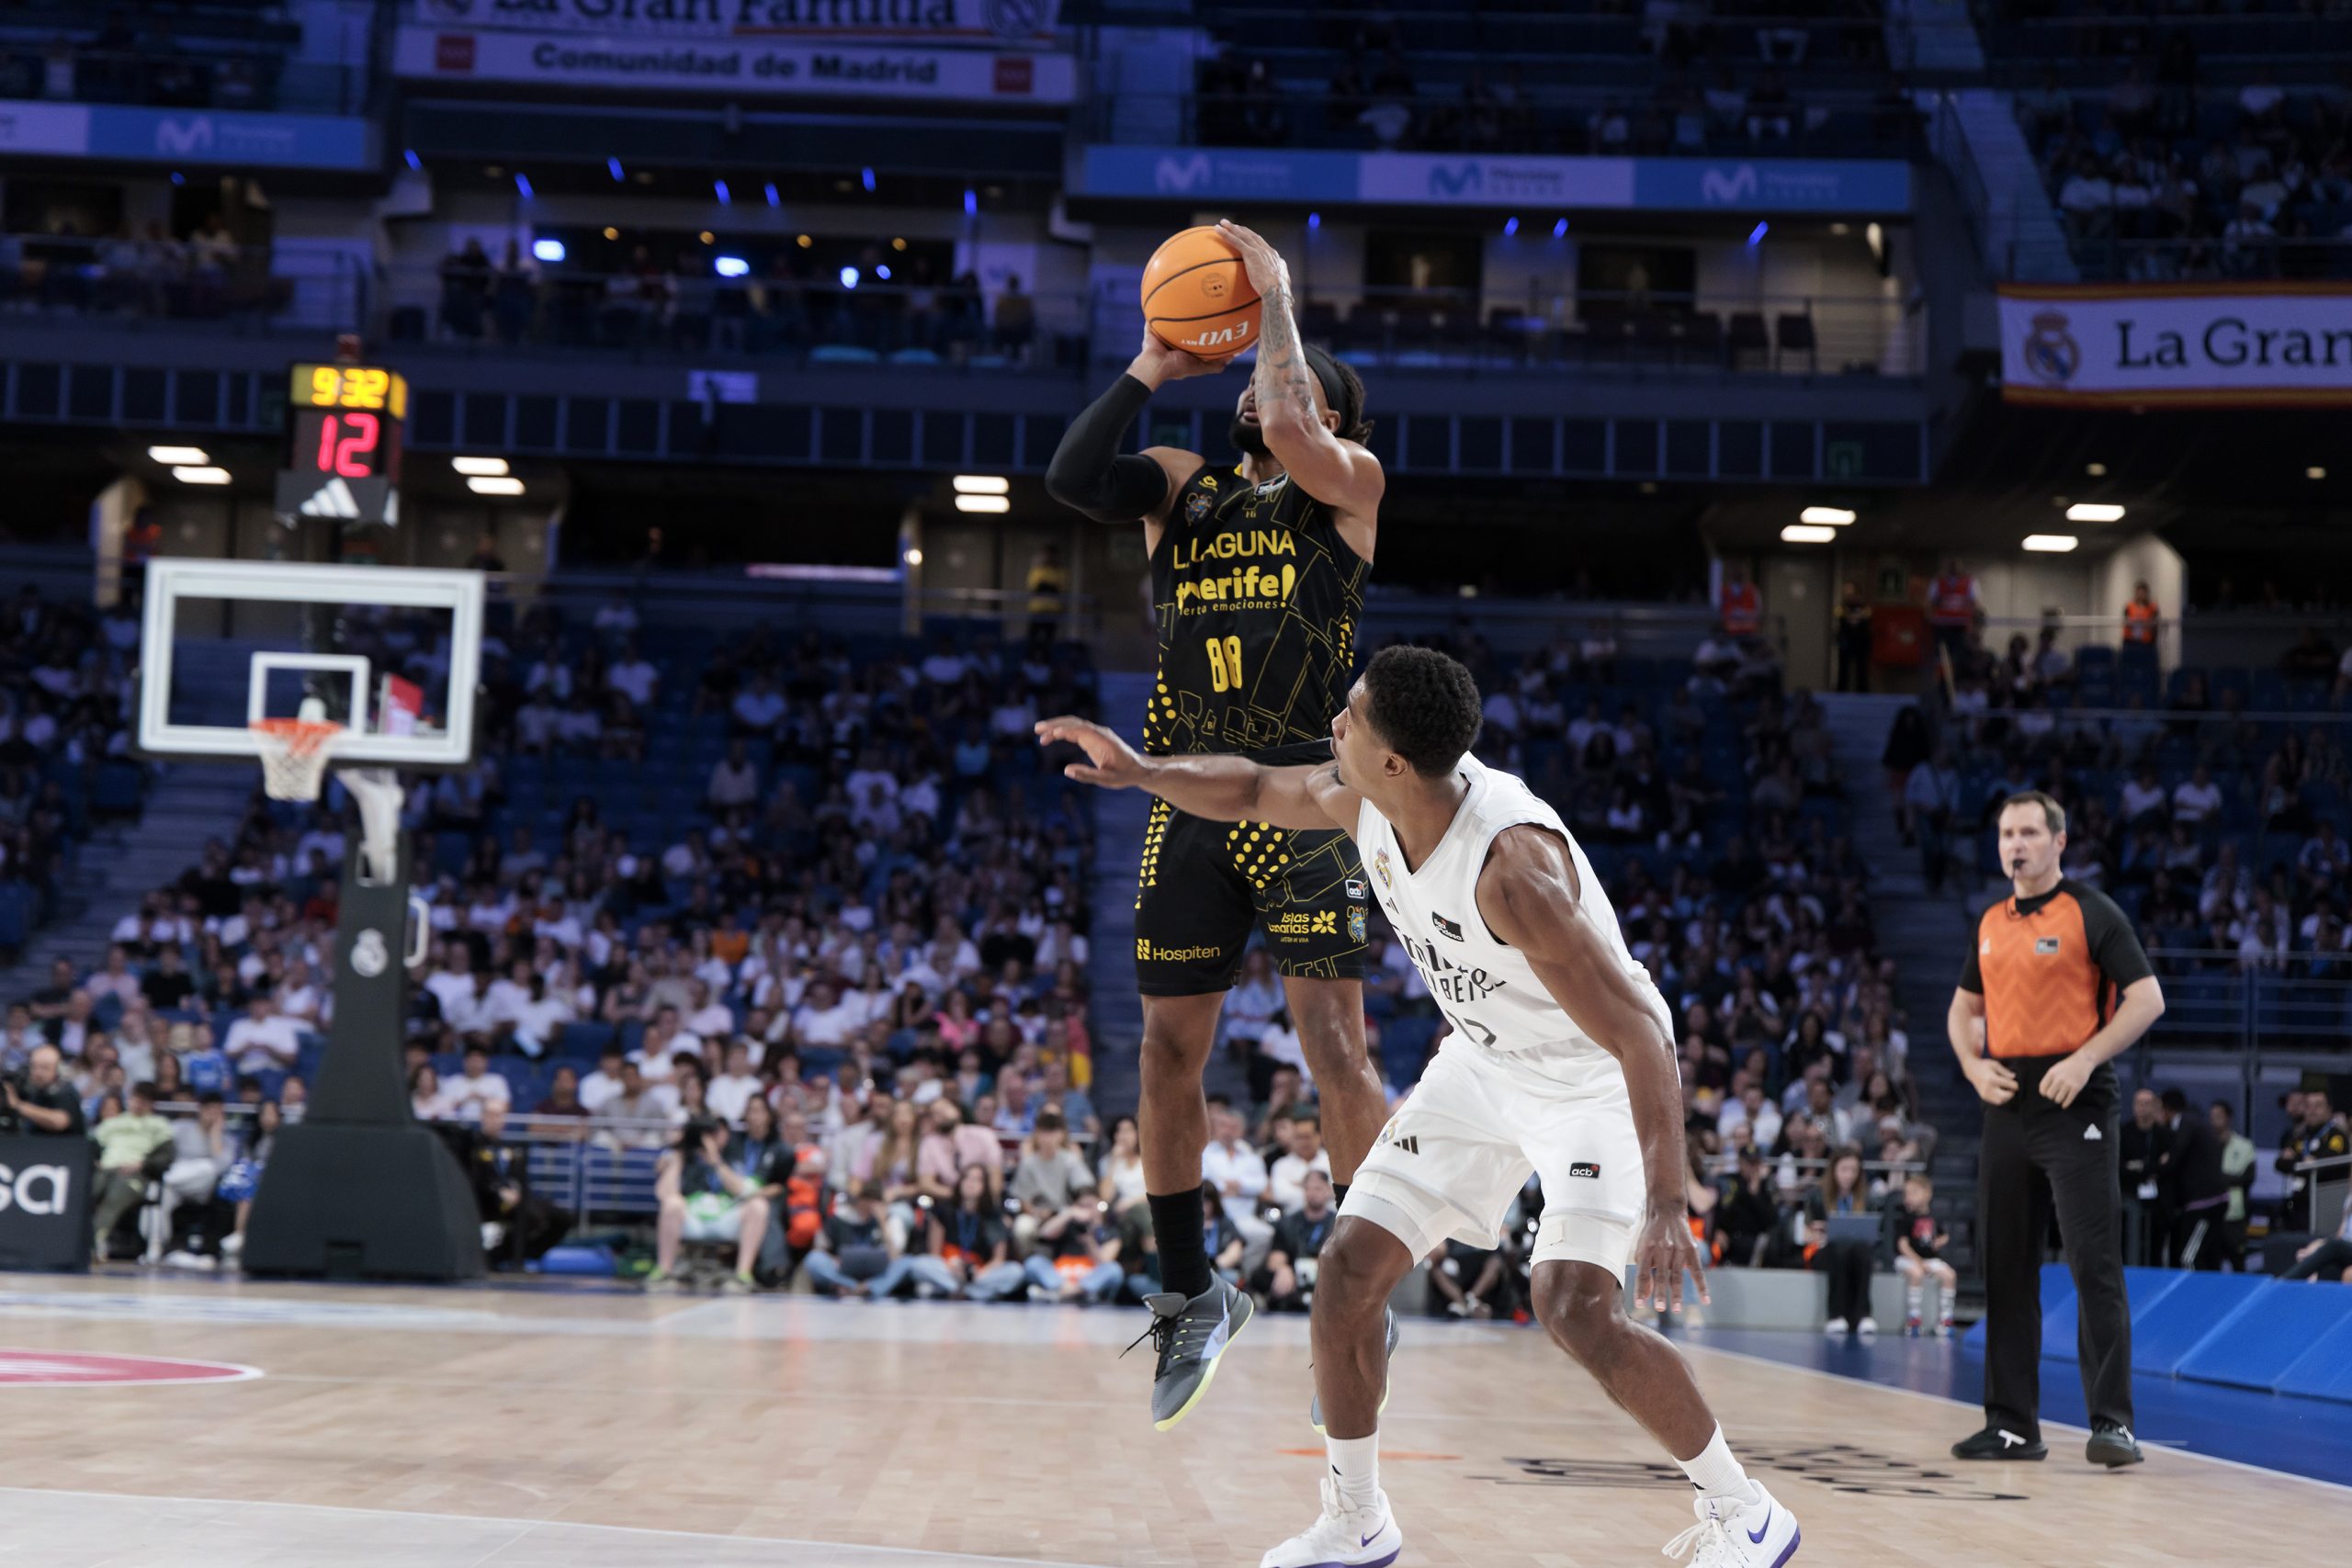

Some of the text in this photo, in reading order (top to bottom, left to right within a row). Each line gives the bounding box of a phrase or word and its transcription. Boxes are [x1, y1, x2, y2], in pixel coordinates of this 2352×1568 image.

[532, 42, 938, 85] Comunidad de Madrid
[2118, 314, 2352, 370] La Gran
[317, 412, 379, 478] 12
[1213, 599, 1278, 612] emociones
[1205, 635, 1243, 694] 88
[1152, 945, 1221, 963] Hospiten
[1571, 1168, 1593, 1177] acb
